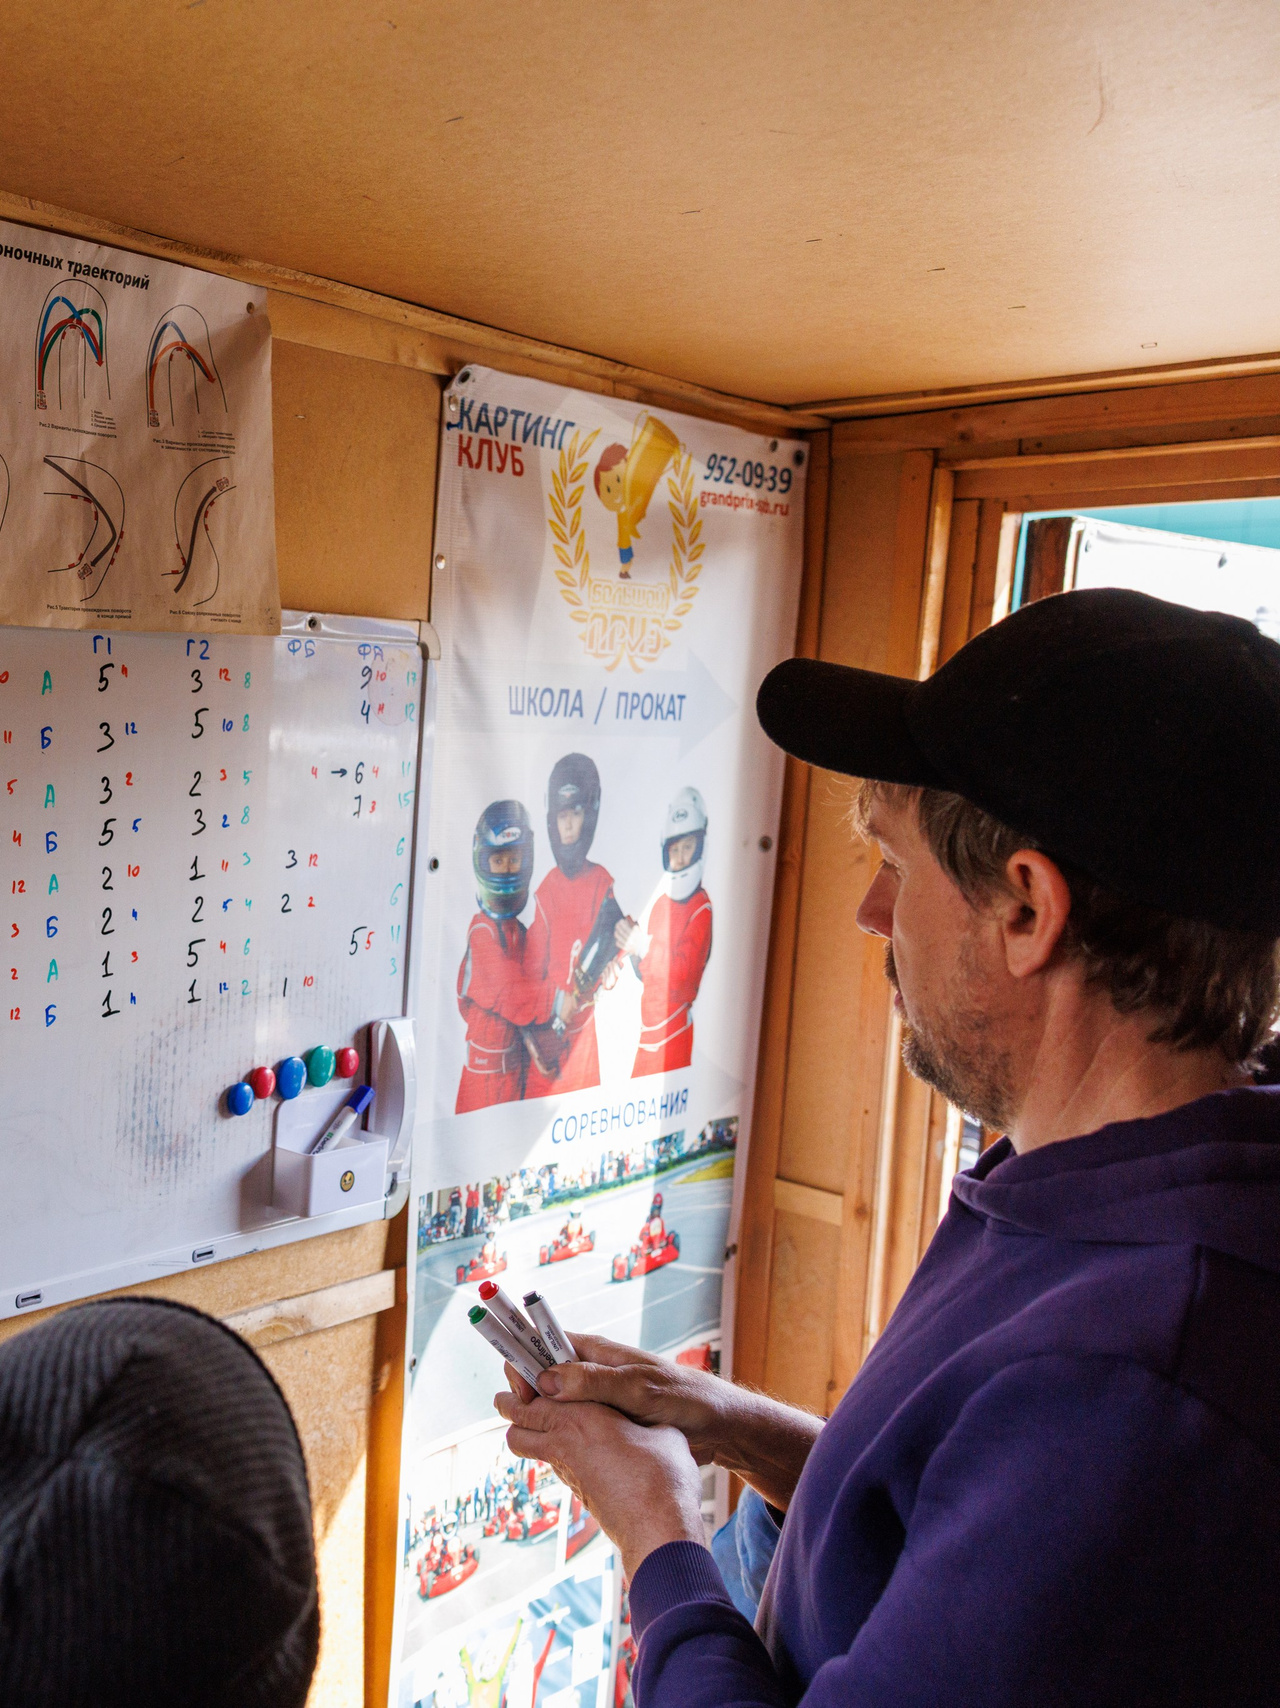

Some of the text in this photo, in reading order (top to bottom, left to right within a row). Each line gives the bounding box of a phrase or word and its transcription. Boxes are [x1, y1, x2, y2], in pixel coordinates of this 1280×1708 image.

[67, 260, 150, 290] траекторий
[459, 397, 575, 451] КАРТИНГ
[457, 434, 524, 477] КЛУБ
[704, 453, 792, 493] 952-09-39
[593, 583, 666, 611] БОЛЬШОЙ
[588, 613, 662, 654] ПРИЗ
[98, 663, 114, 692] 5
[191, 669, 203, 693] 3
[219, 668, 231, 681] 12
[360, 665, 372, 689] 9
[375, 670, 386, 681] 10
[509, 685, 583, 718] ШКОЛА
[616, 692, 686, 721] ПРОКАТ
[41, 726, 53, 749] Б
[97, 722, 115, 753] 3
[125, 722, 138, 735] 12
[191, 708, 209, 739] 5
[222, 718, 233, 732] 10
[361, 700, 370, 724] 4
[7, 779, 18, 795] 5
[99, 776, 112, 804] 3
[189, 771, 202, 797] 2
[355, 762, 364, 784] 6
[46, 831, 57, 853] Б
[99, 818, 117, 846] 5
[192, 809, 207, 836] 3
[12, 880, 26, 894] 12
[102, 866, 113, 891] 2
[127, 864, 140, 877] 10
[189, 855, 205, 881] 1
[285, 850, 298, 869] 3
[396, 837, 405, 856] 6
[46, 916, 58, 938] Б
[101, 907, 115, 935] 2
[192, 896, 204, 923] 2
[281, 893, 292, 913] 2
[390, 882, 403, 906] 6
[102, 951, 113, 978] 1
[187, 939, 206, 967] 5
[349, 926, 367, 955] 5
[10, 1007, 20, 1020] 12
[45, 1004, 56, 1027] Б
[102, 990, 120, 1018] 1
[187, 979, 201, 1004] 1
[283, 977, 288, 997] 1
[389, 958, 397, 976] 3
[552, 1088, 688, 1144] СОРЕВНОВАНИЯ
[531, 1336, 555, 1366] berlingo
